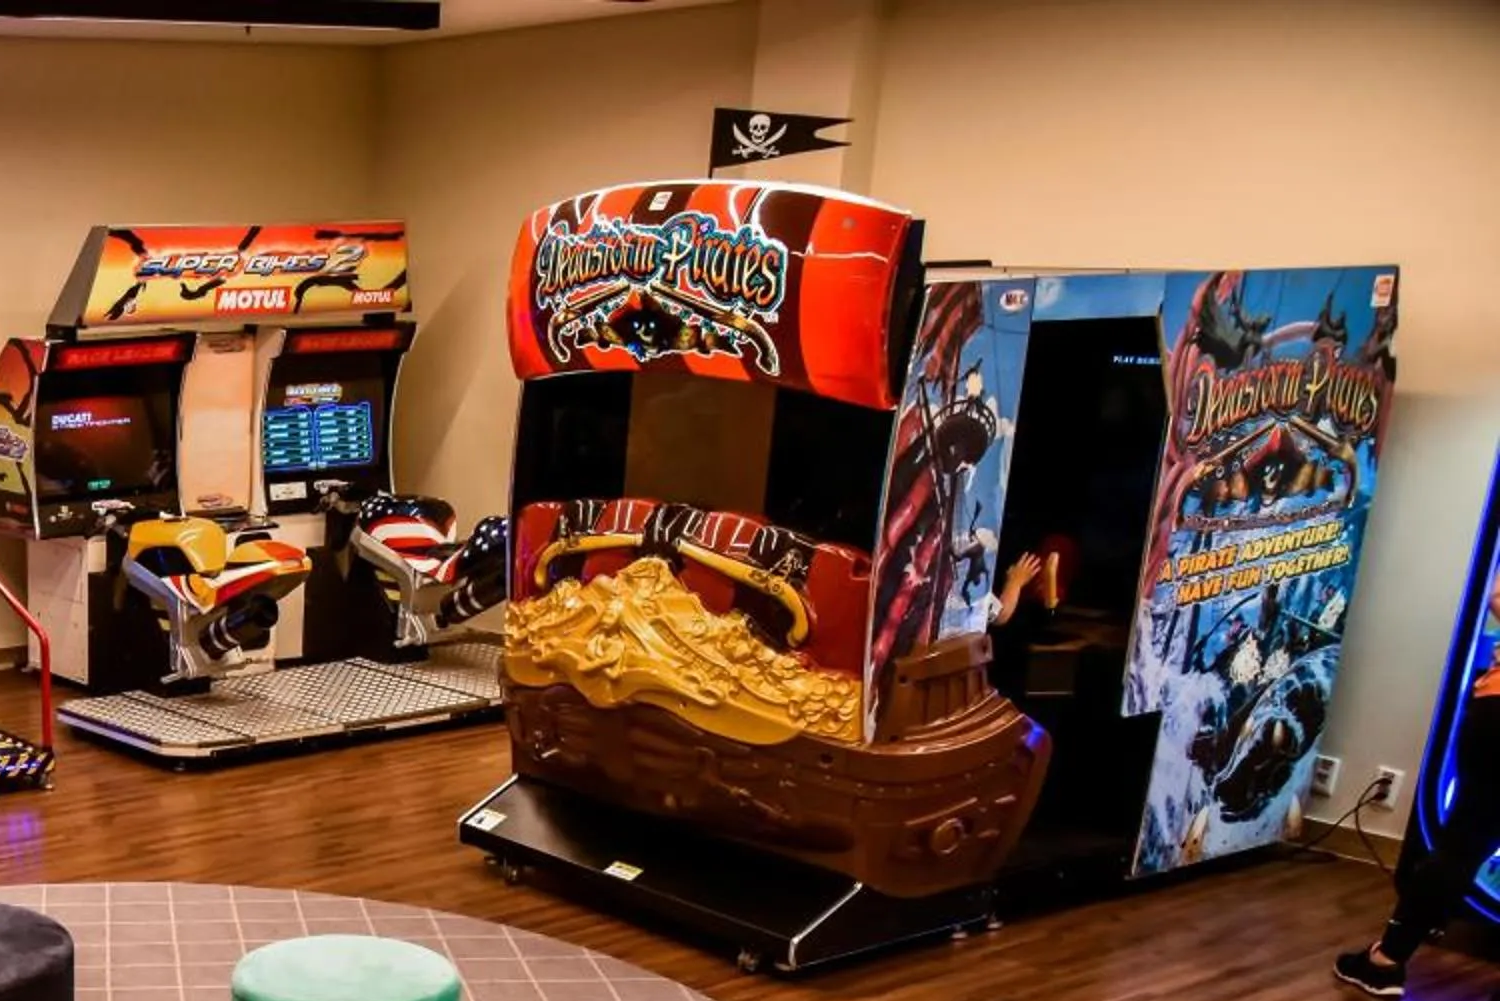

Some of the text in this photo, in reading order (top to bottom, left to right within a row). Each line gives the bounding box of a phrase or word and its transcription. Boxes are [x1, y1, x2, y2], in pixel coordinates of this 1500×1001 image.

[136, 242, 366, 277] SUPER BIKES 2
[218, 290, 287, 310] MOTUL
[352, 291, 392, 304] MOTUL
[52, 411, 92, 424] DUCATI
[1158, 522, 1343, 582] A PIRATE ADVENTURE!
[1177, 546, 1350, 605] HAVE FUN TOGETHER!
